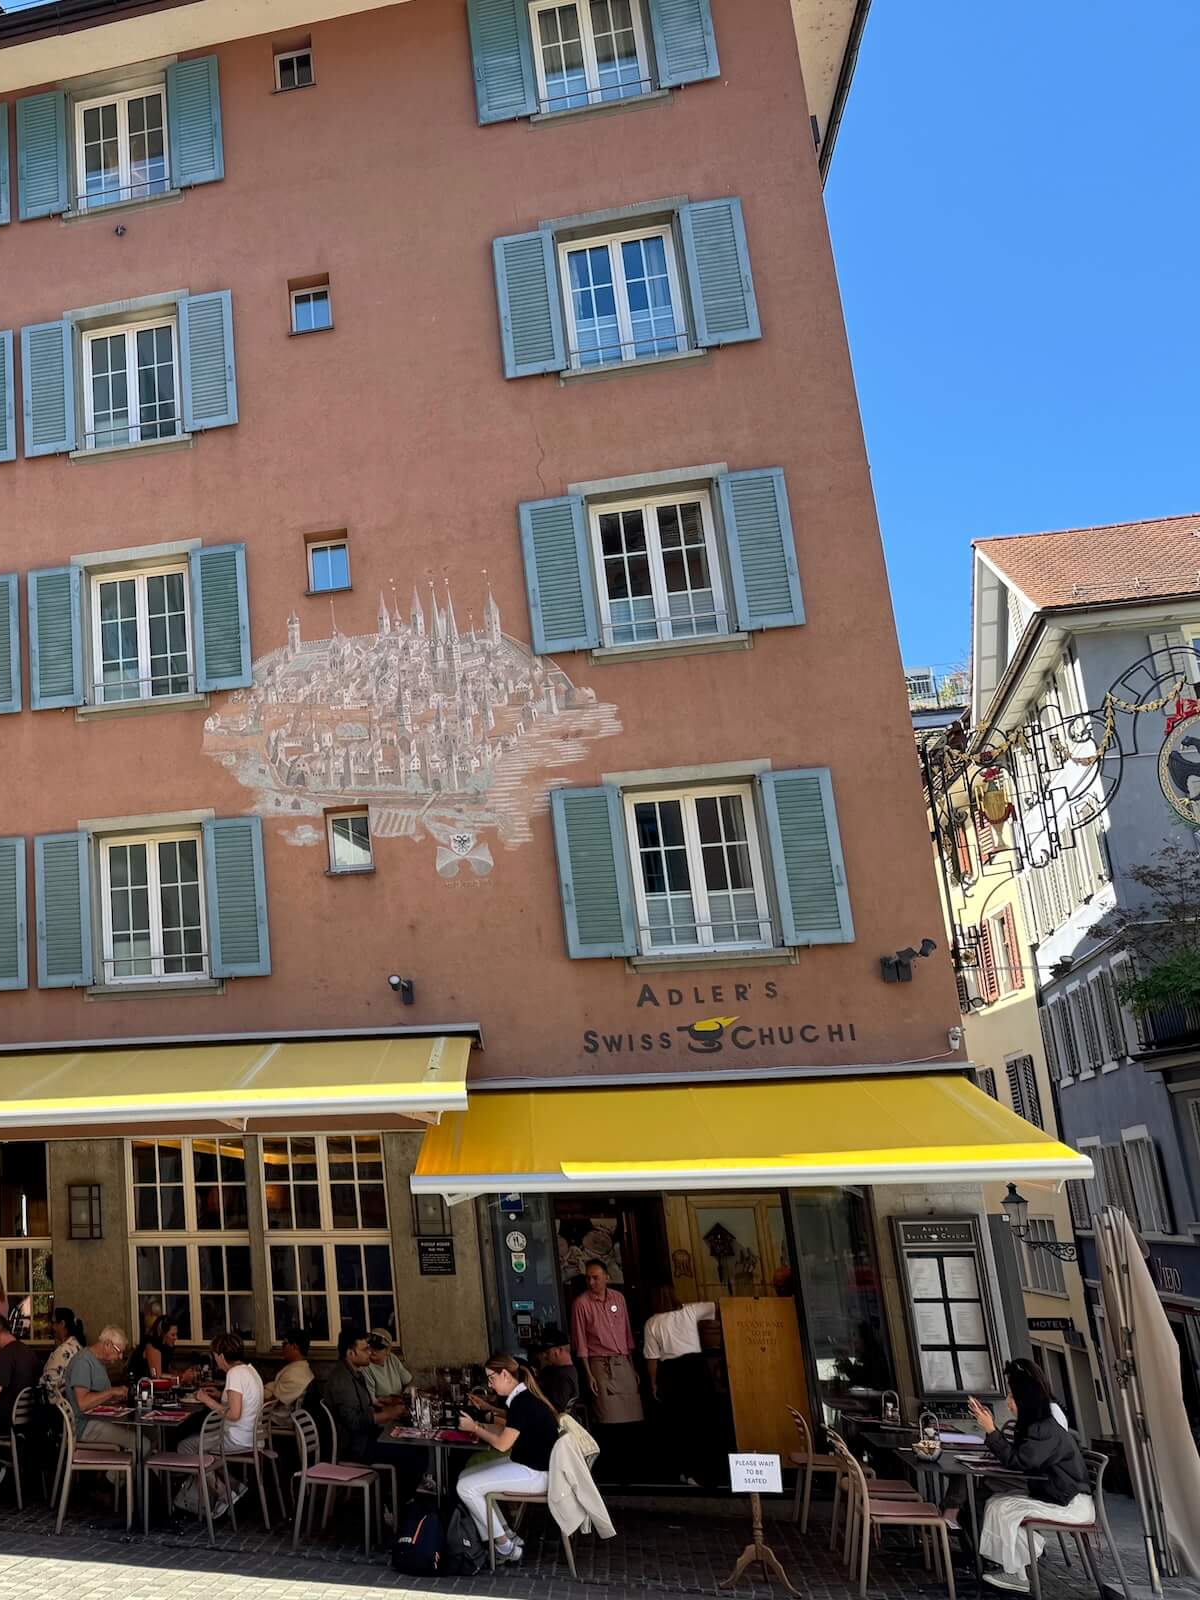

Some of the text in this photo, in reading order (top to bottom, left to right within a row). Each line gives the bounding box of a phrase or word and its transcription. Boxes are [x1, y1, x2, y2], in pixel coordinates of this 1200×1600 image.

[583, 1023, 857, 1054] SWISS CHUCHI
[1031, 1320, 1065, 1329] HOTEL
